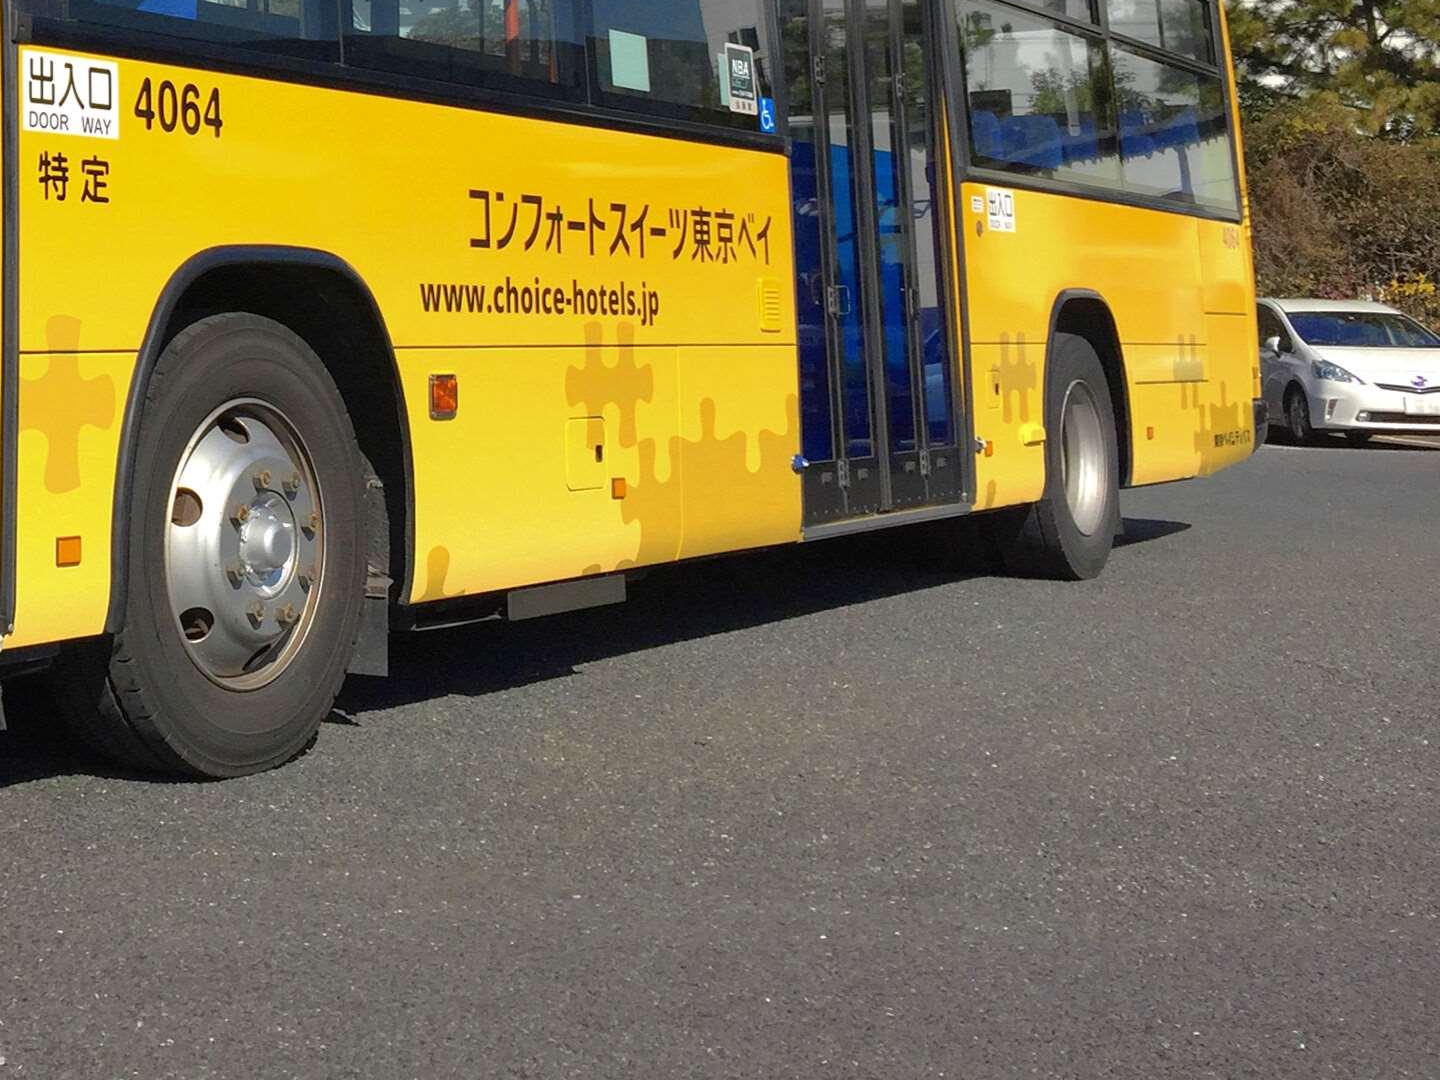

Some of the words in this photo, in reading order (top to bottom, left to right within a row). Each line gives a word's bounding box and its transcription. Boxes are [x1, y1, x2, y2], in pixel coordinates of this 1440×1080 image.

[29, 57, 112, 110] 出入口
[134, 77, 223, 138] 4064
[29, 111, 69, 130] DOOR
[81, 116, 111, 135] WAY
[38, 151, 110, 203] 特定
[468, 189, 772, 265] コンフォートスイーツ東京ベイ
[420, 276, 659, 326] www.choice-hotels.jp
